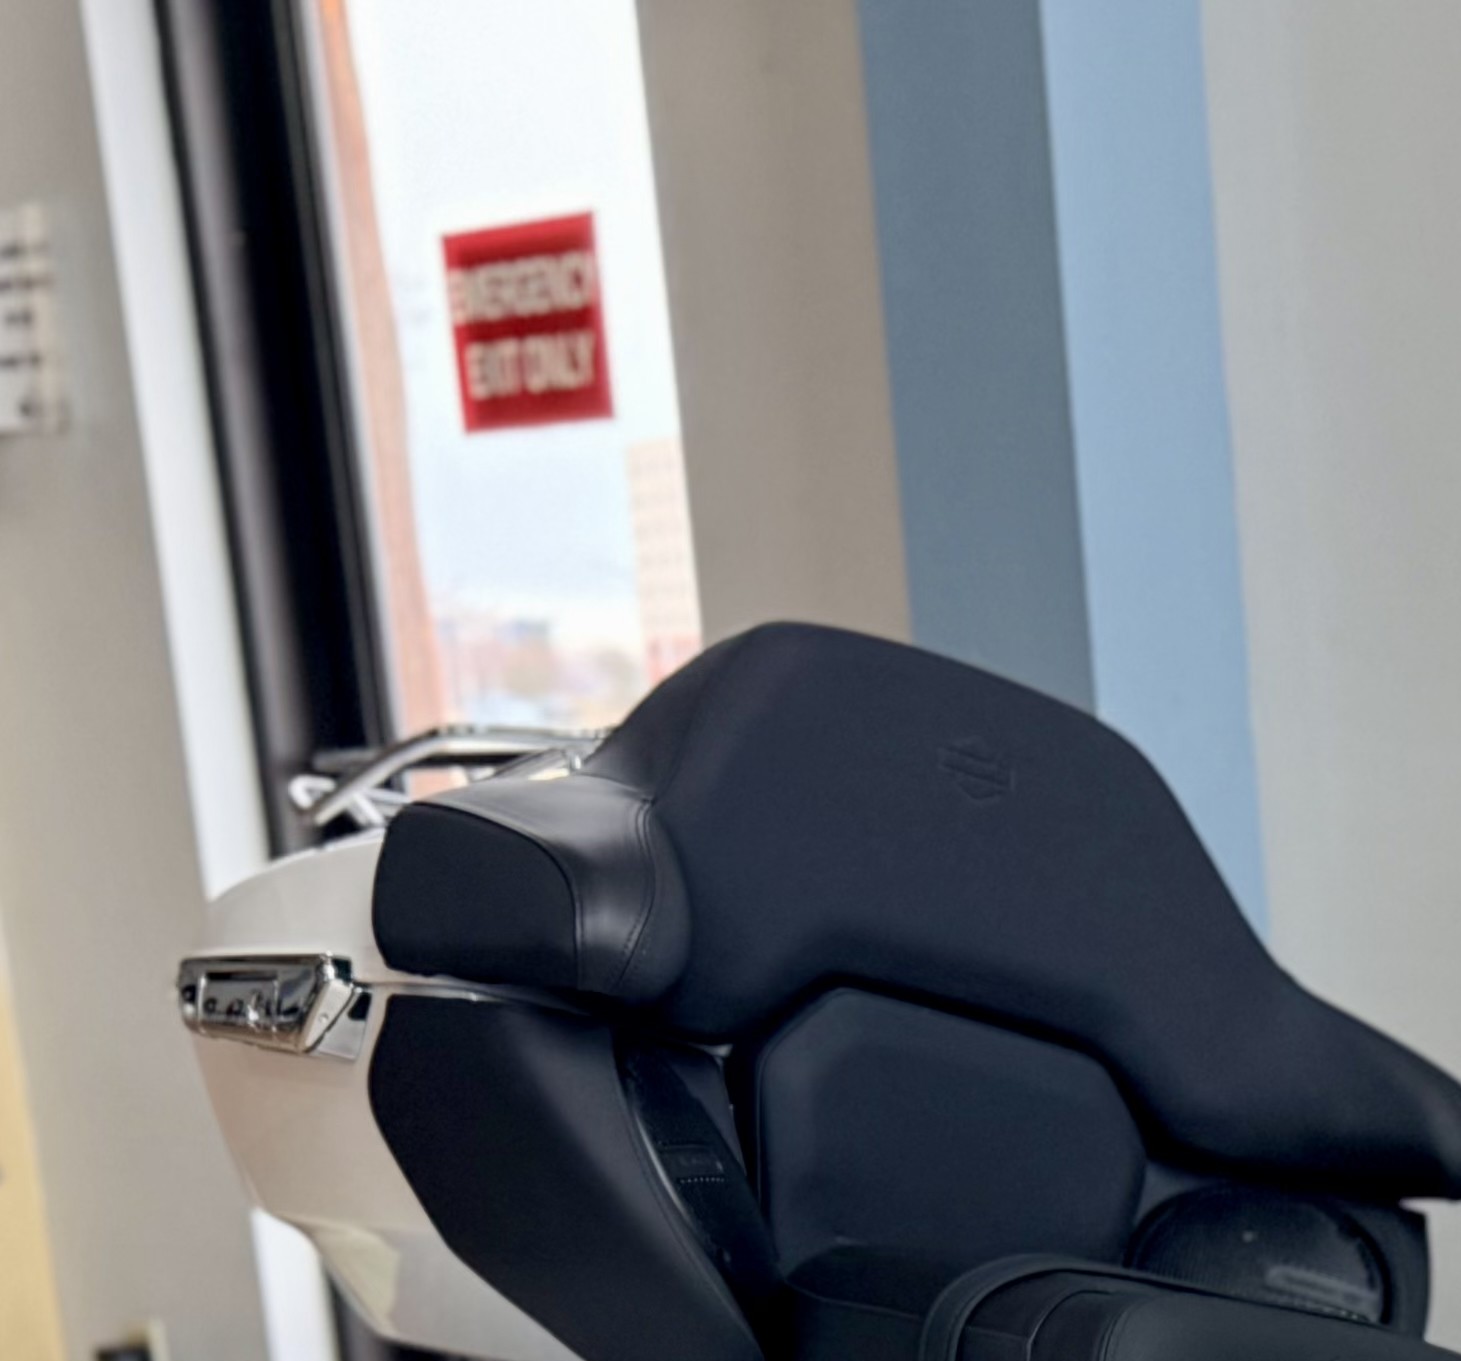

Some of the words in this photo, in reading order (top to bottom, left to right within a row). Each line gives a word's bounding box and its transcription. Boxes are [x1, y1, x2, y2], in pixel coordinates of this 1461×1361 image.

[449, 250, 597, 325] EMERGENCY
[466, 337, 521, 400] EXIT
[524, 329, 596, 394] ONLY
